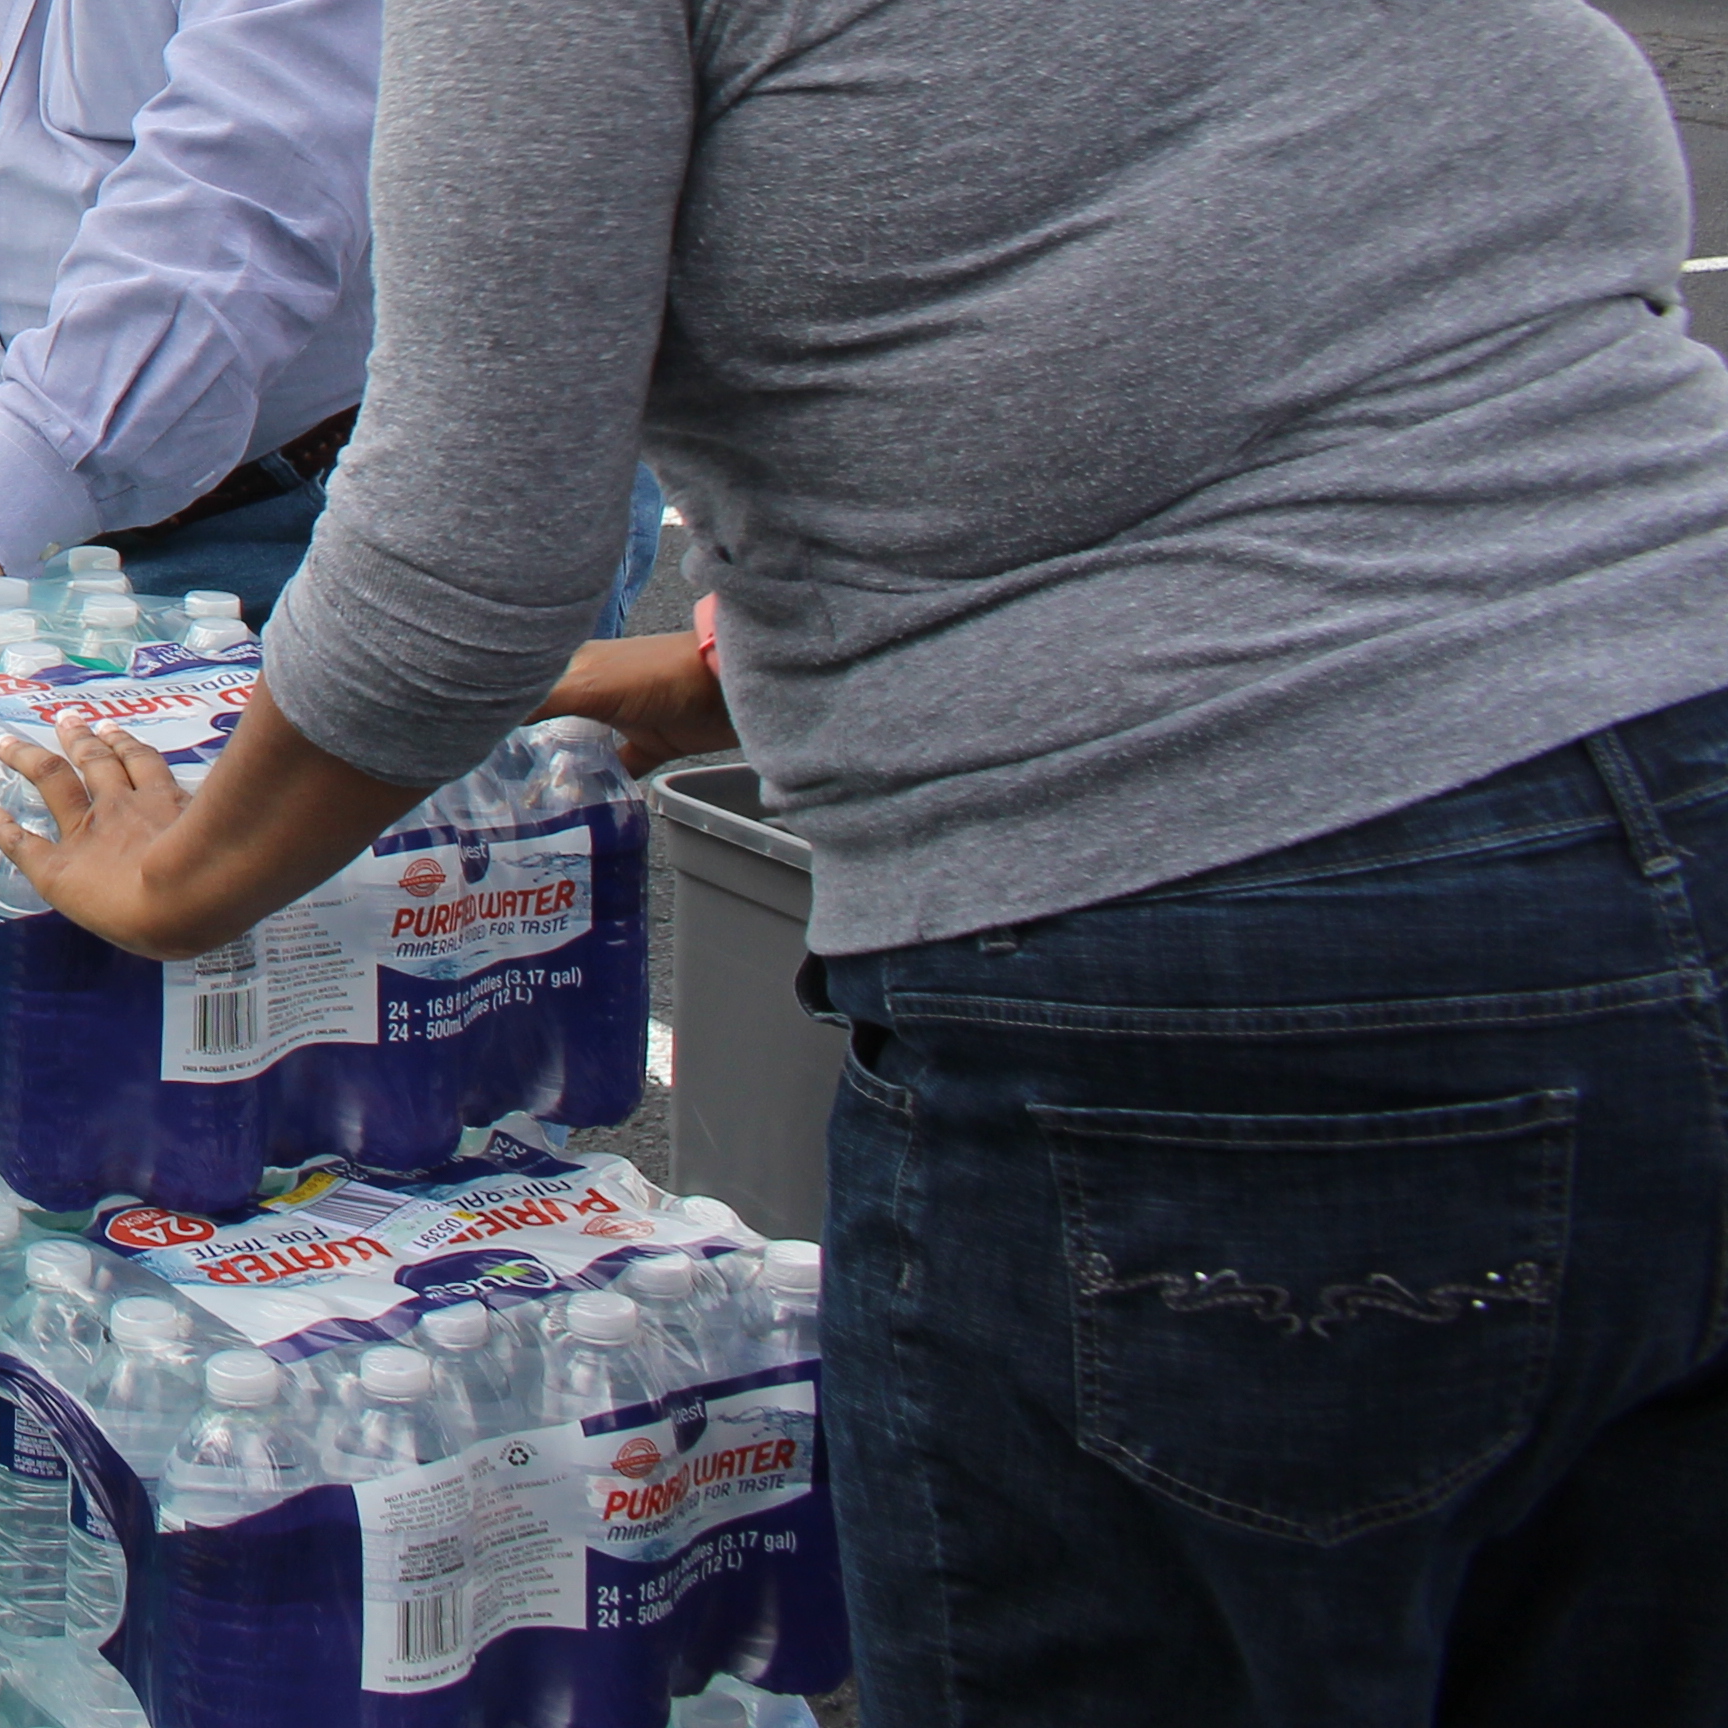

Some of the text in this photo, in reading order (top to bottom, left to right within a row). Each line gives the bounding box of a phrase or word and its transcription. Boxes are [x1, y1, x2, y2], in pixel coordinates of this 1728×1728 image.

[103, 685, 166, 699] FOR
[176, 672, 254, 694] ADDED
[479, 879, 577, 920] WATER
[396, 933, 464, 958] MINERALS
[488, 920, 515, 936] FOR
[520, 913, 570, 934] TASTE
[388, 967, 583, 1020] 24 16.9 bottles (3.17 gal)
[388, 1022, 409, 1042] 24
[492, 988, 511, 1012] (12
[515, 987, 534, 1005] L)
[122, 1207, 157, 1228] PACK
[141, 1214, 204, 1245] 24
[185, 1179, 574, 1261] MINERAL FOR TASTE
[413, 1215, 466, 1252] 05391
[201, 1235, 395, 1285] WATER
[693, 1438, 798, 1487] WATER
[704, 1473, 787, 1502] FOR TASTE
[597, 1585, 621, 1606] 24
[638, 1574, 666, 1603] 16.9
[718, 1531, 759, 1555] (3.17
[763, 1531, 798, 1553] gal)
[597, 1608, 621, 1628] 24
[701, 1553, 724, 1581] (12
[727, 1552, 744, 1570] L)
